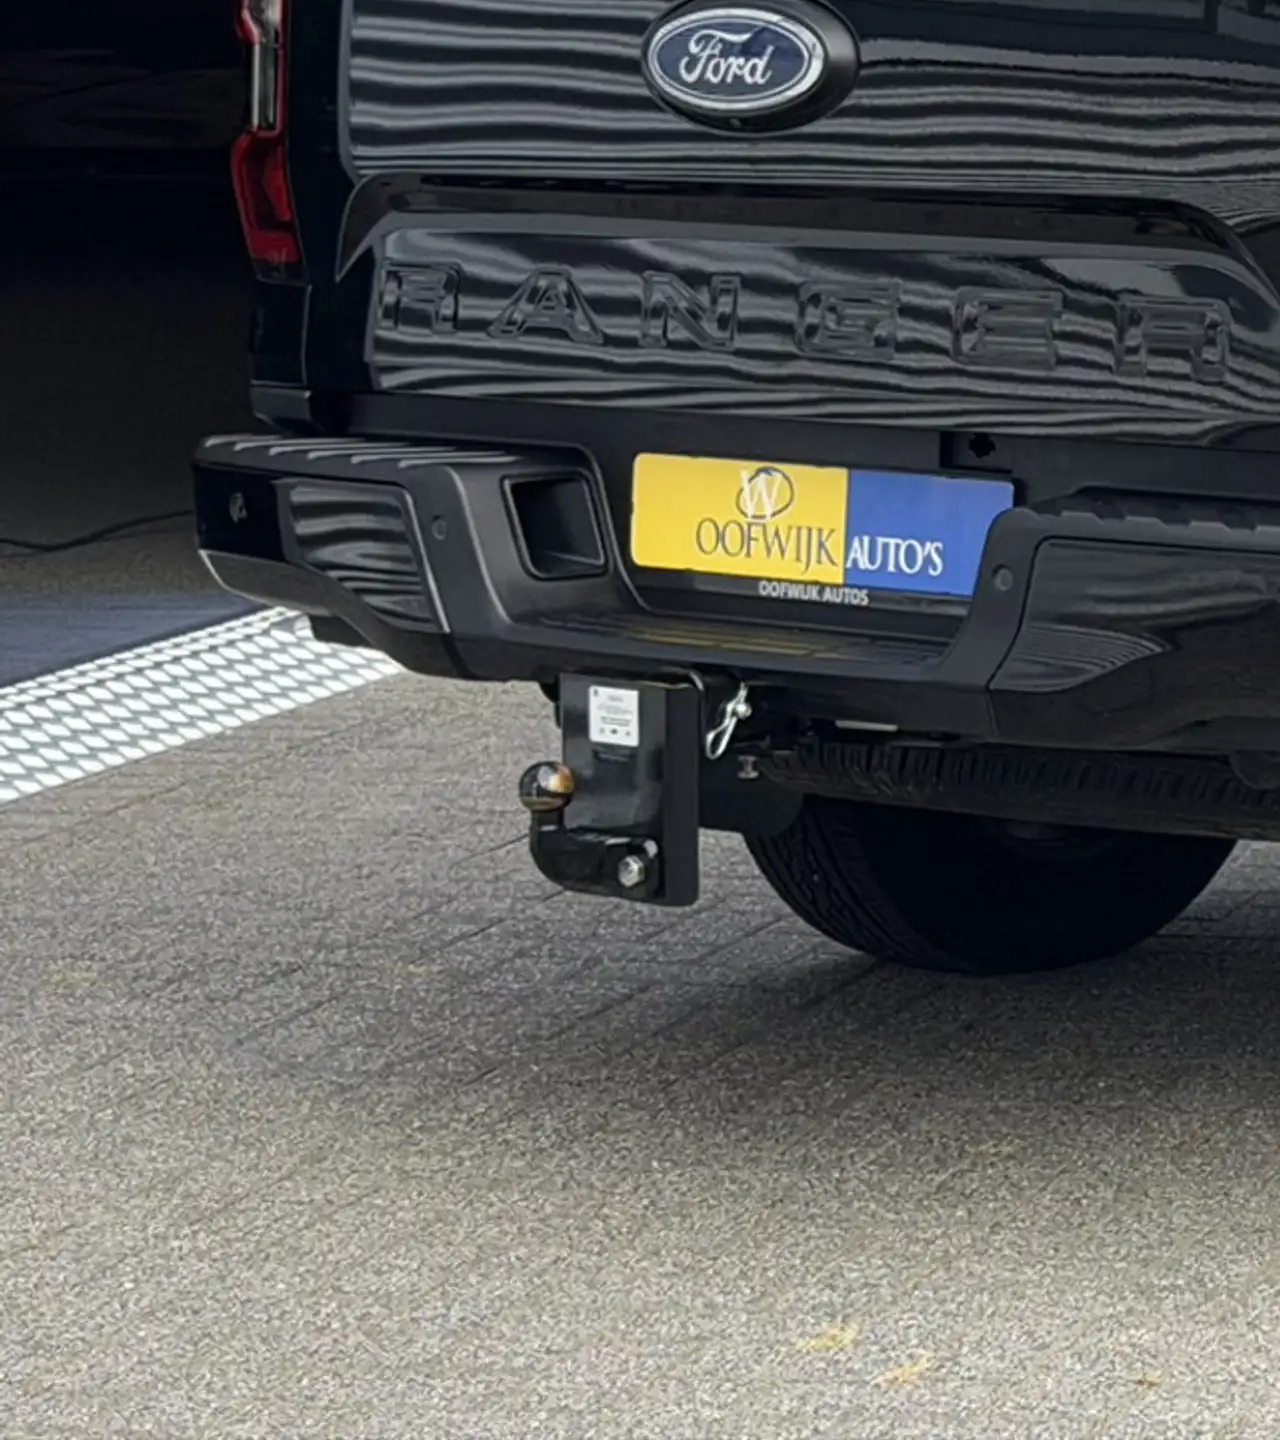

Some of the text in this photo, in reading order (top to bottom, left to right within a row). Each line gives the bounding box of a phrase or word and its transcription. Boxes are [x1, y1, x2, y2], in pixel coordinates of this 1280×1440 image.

[679, 26, 776, 85] Ford
[376, 260, 1231, 382] RANGER
[696, 517, 943, 576] OOFWIJK AUTO'S
[823, 587, 869, 606] AUTOS
